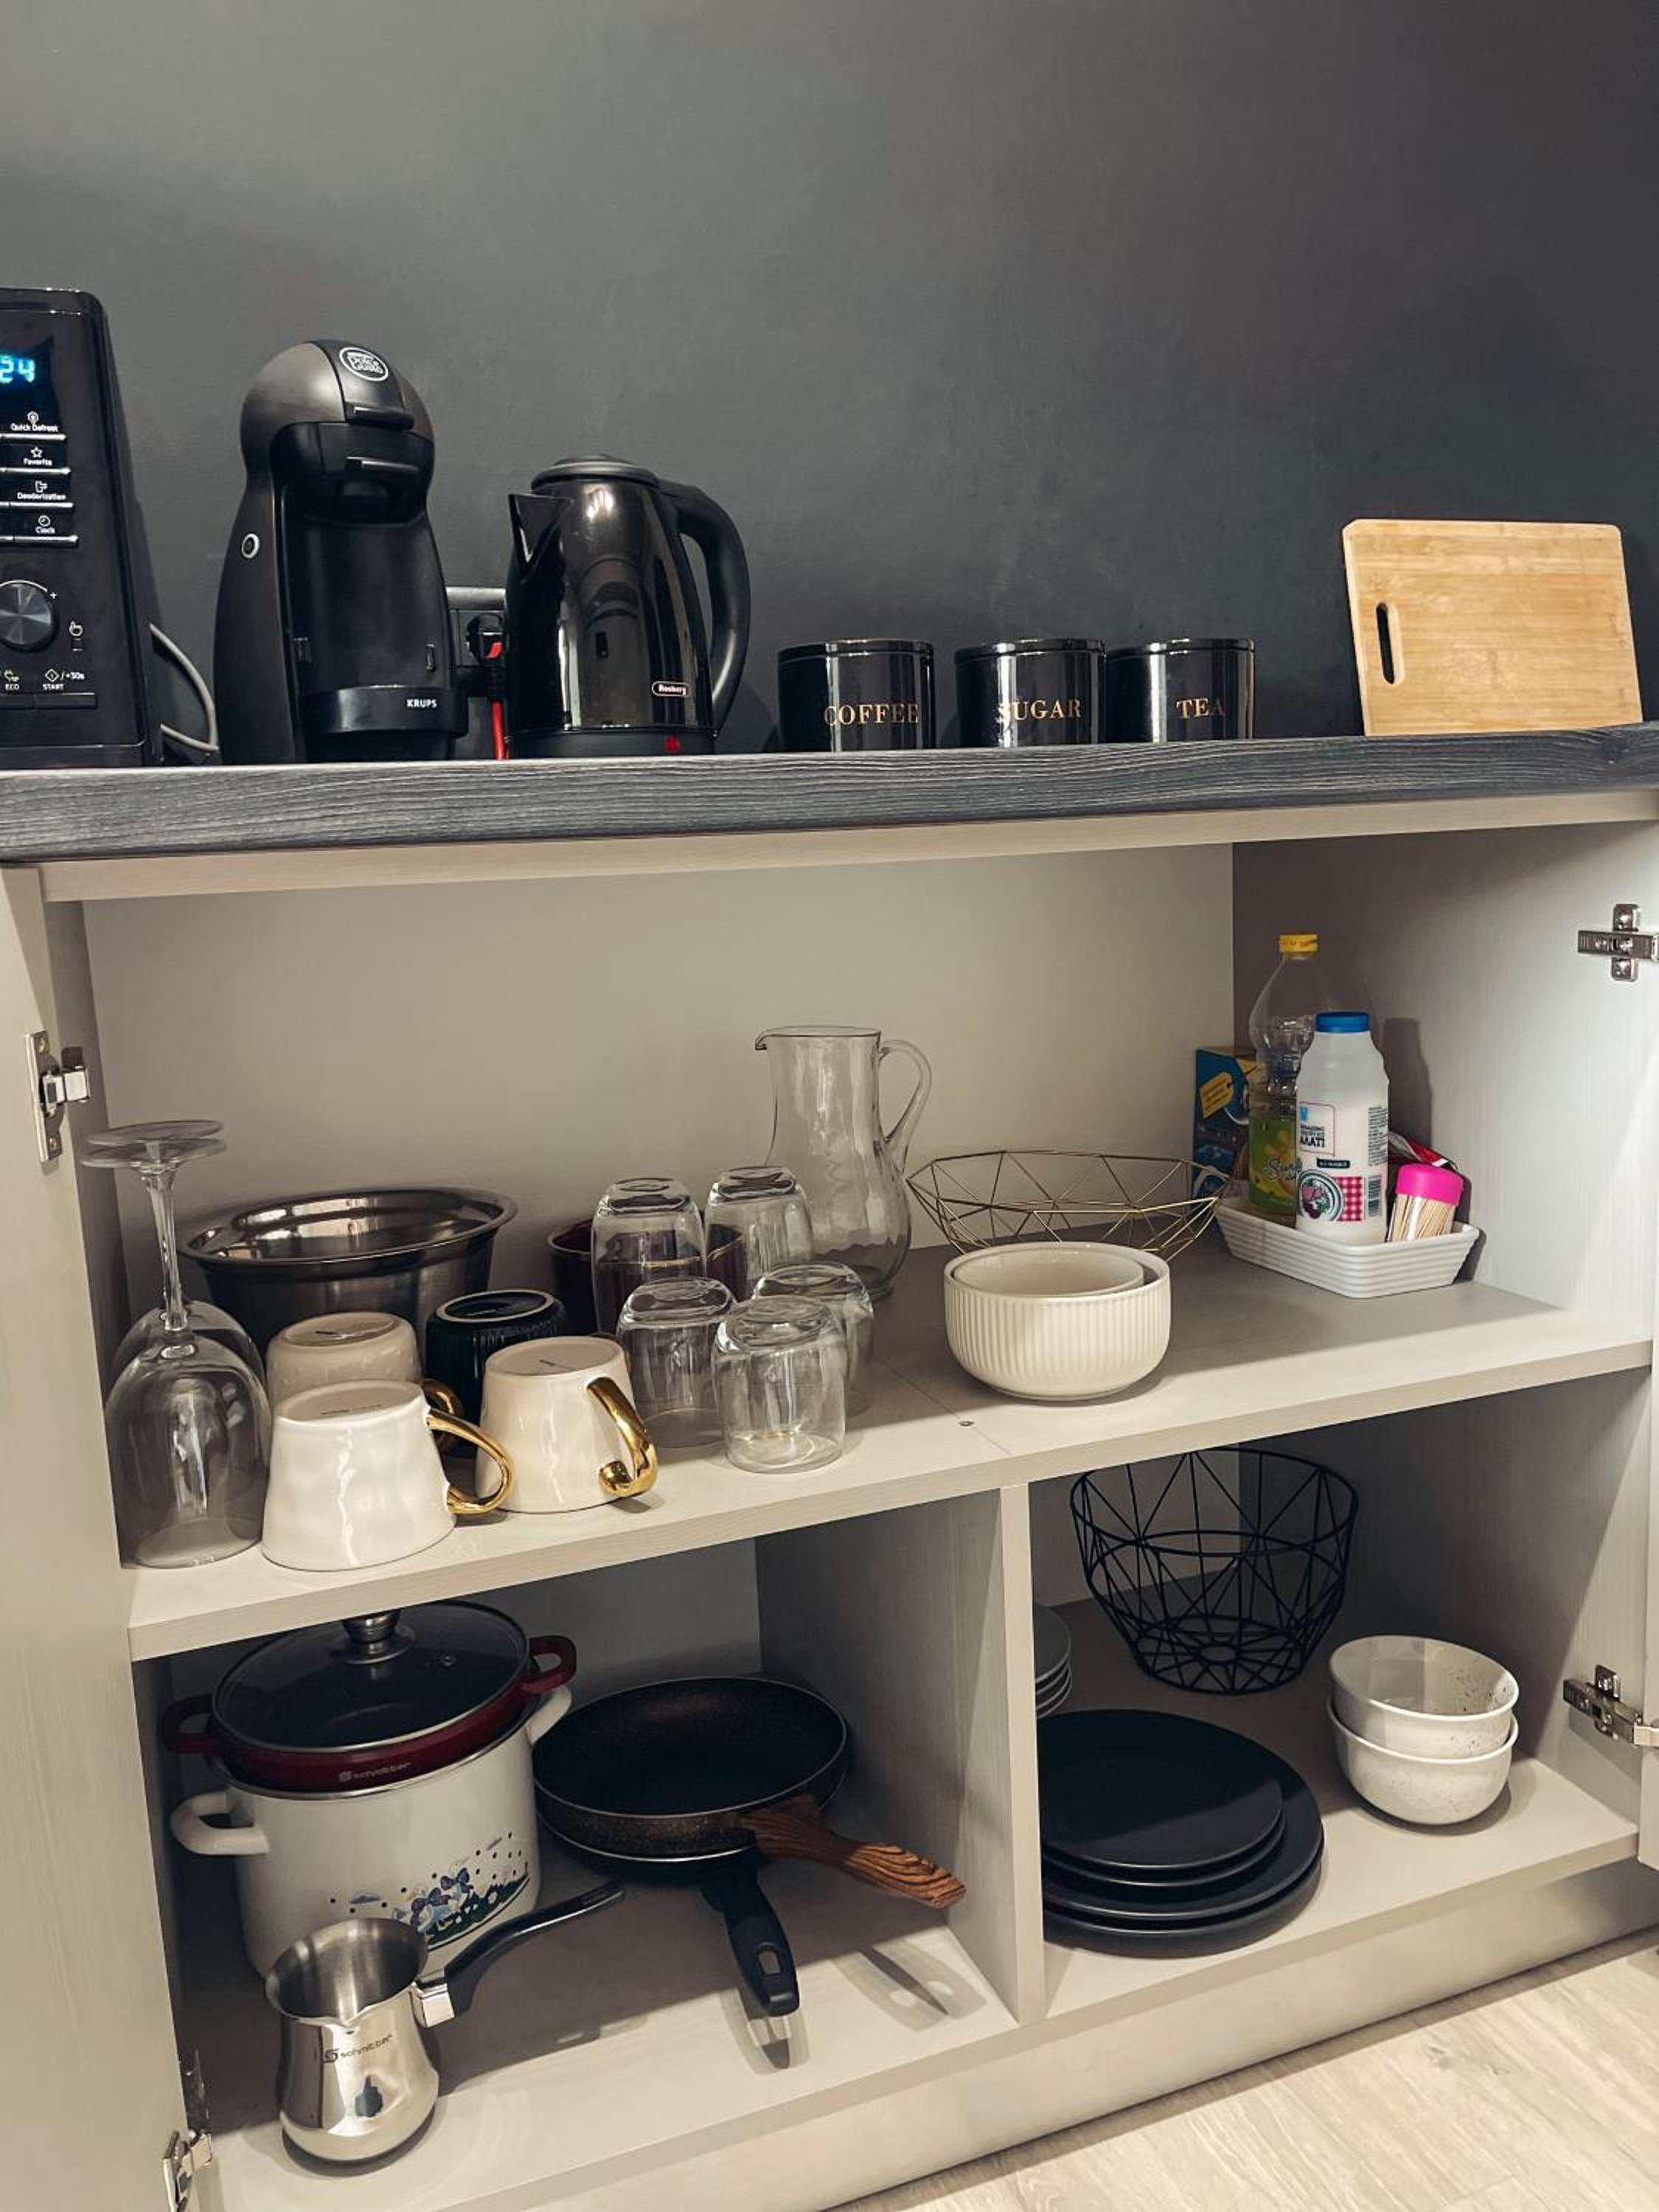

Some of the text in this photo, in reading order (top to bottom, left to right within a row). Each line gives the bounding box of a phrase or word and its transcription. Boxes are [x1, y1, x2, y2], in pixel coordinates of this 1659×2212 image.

[10, 422, 58, 432] Quick Defrost
[35, 526, 55, 535] Clock
[406, 698, 437, 708] KRUPS
[1176, 697, 1226, 719] TEA
[824, 703, 919, 726] COFFEE
[998, 699, 1082, 725] SUGAR
